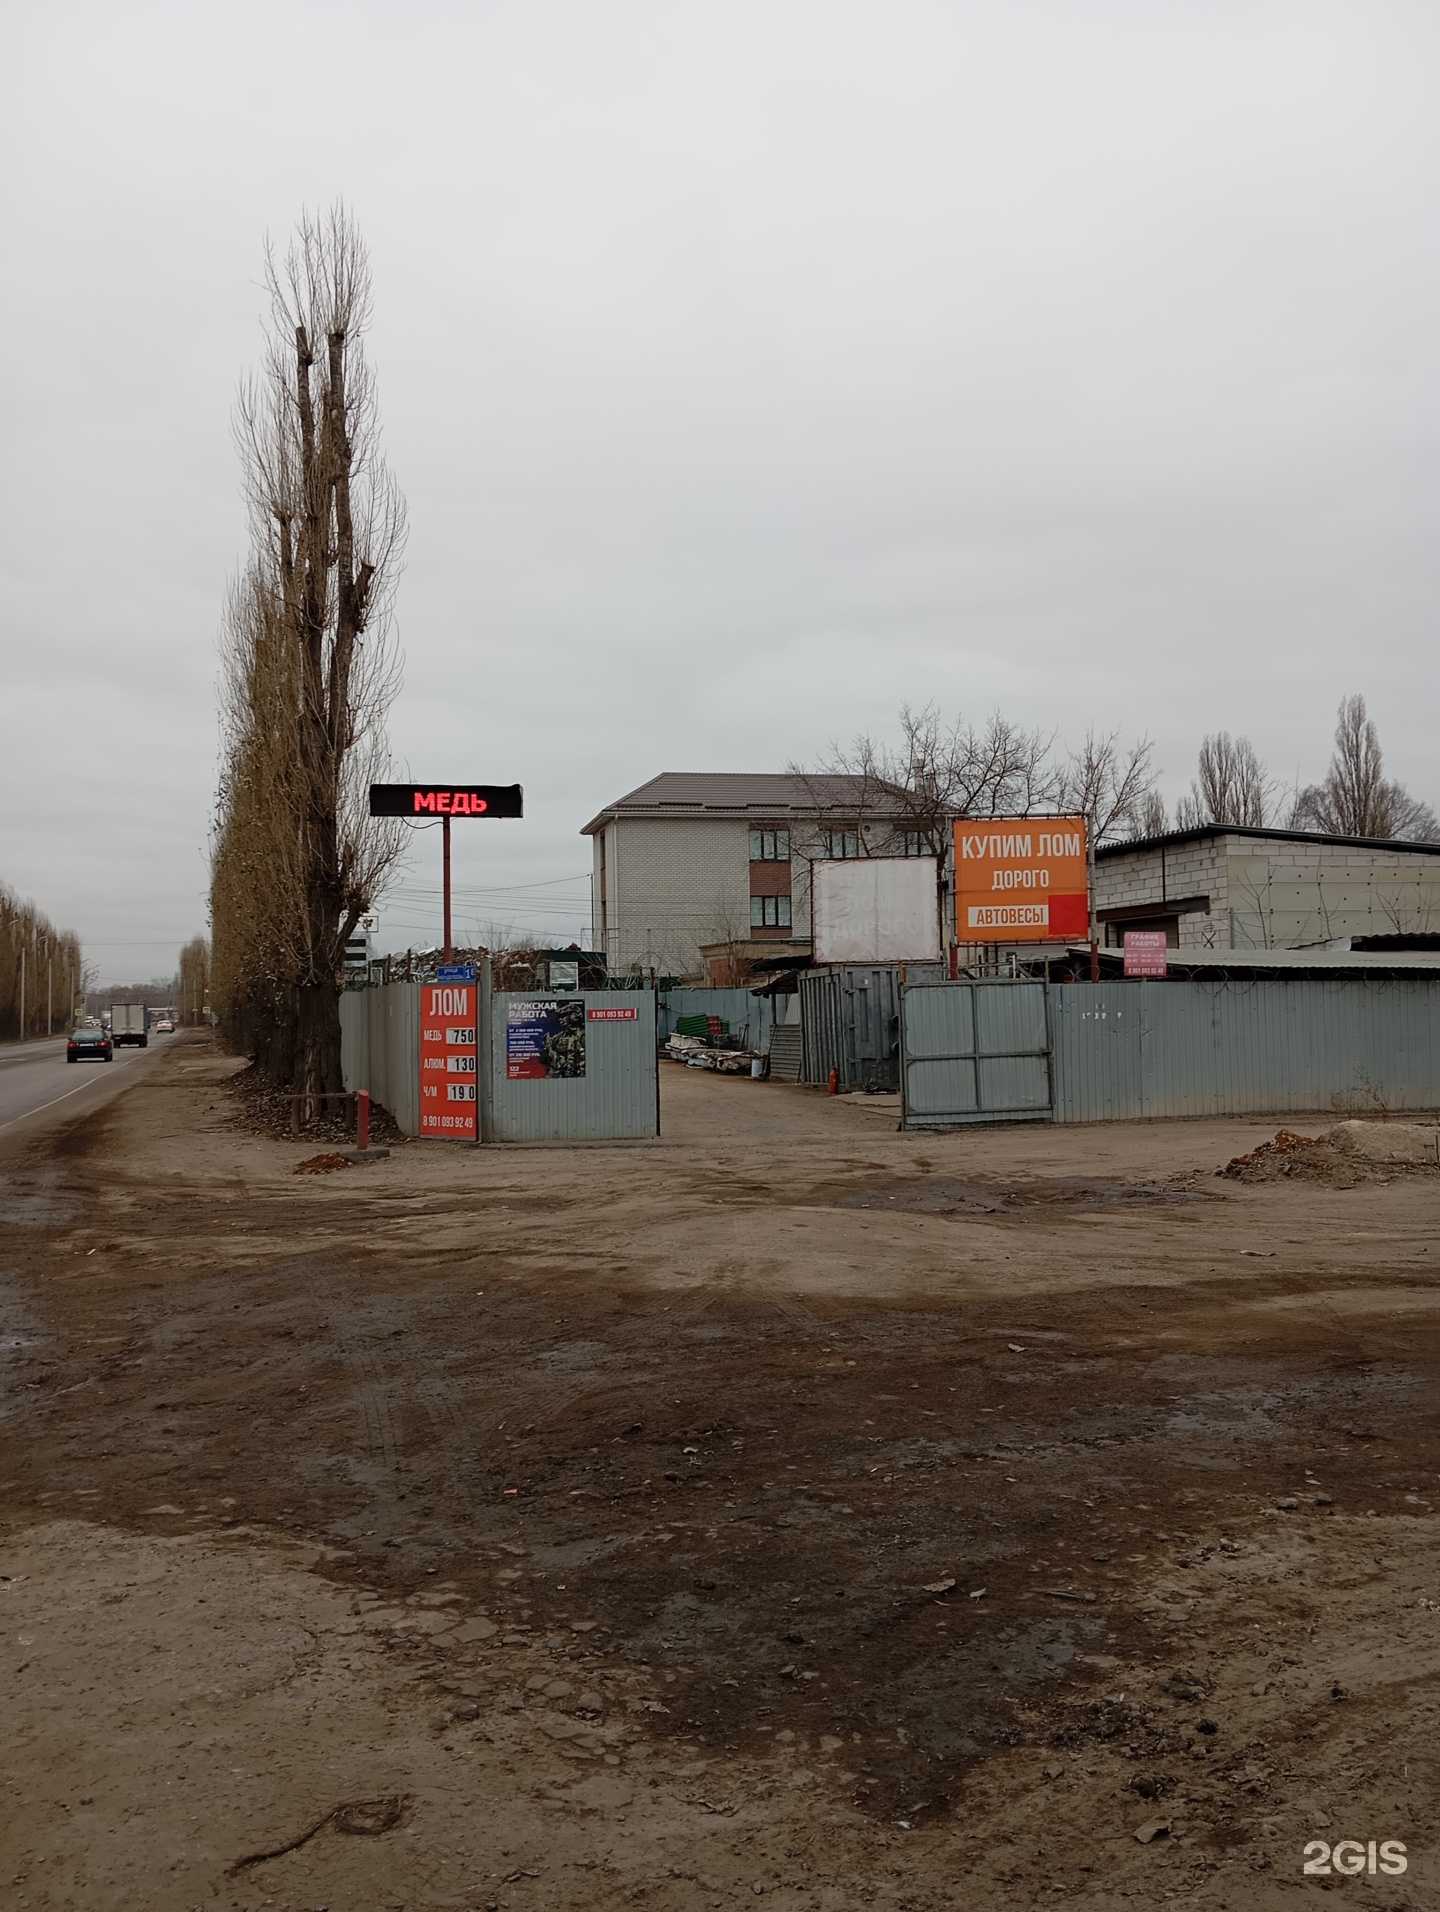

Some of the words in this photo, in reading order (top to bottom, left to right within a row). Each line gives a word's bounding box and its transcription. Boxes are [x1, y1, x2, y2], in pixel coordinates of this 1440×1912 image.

[414, 792, 487, 814] МЕДЬ
[962, 834, 1032, 859] КУПИМ
[1037, 833, 1080, 857] ЛОМ
[991, 869, 1049, 890] ДОРОГО
[976, 907, 1044, 925] АВТОВЕСЫ
[429, 988, 468, 1016] ЛОМ
[508, 1002, 558, 1010] МУЖСКАЯ
[508, 1010, 548, 1018] РАБОТА
[423, 1029, 442, 1041] МЕДЬ
[453, 1029, 474, 1043] 750
[455, 1057, 475, 1071] 130
